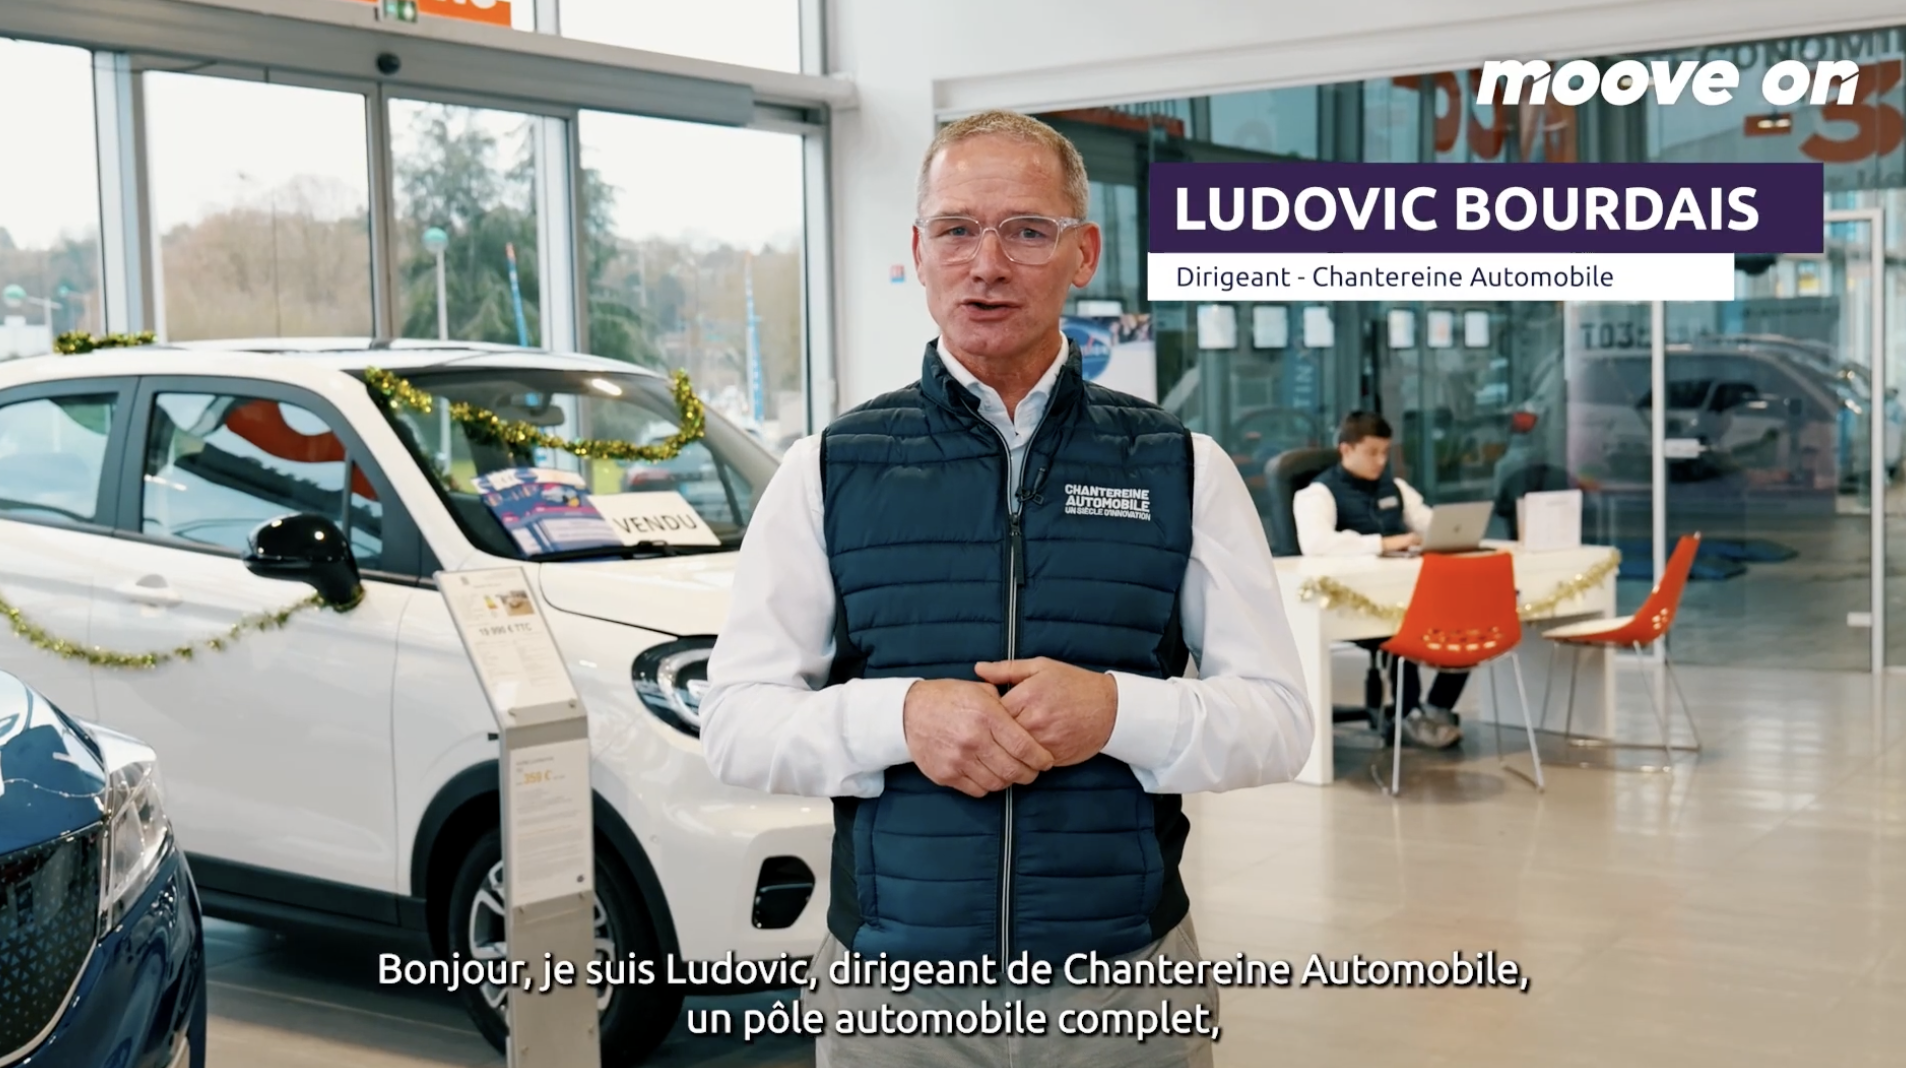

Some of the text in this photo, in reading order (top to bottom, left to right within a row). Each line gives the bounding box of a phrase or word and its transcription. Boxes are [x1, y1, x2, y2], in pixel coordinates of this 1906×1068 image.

[1064, 483, 1150, 500] CHANTEREINE
[1064, 507, 1076, 515] UN
[1065, 495, 1151, 512] AUTOMOBILE
[612, 513, 698, 535] VENDU
